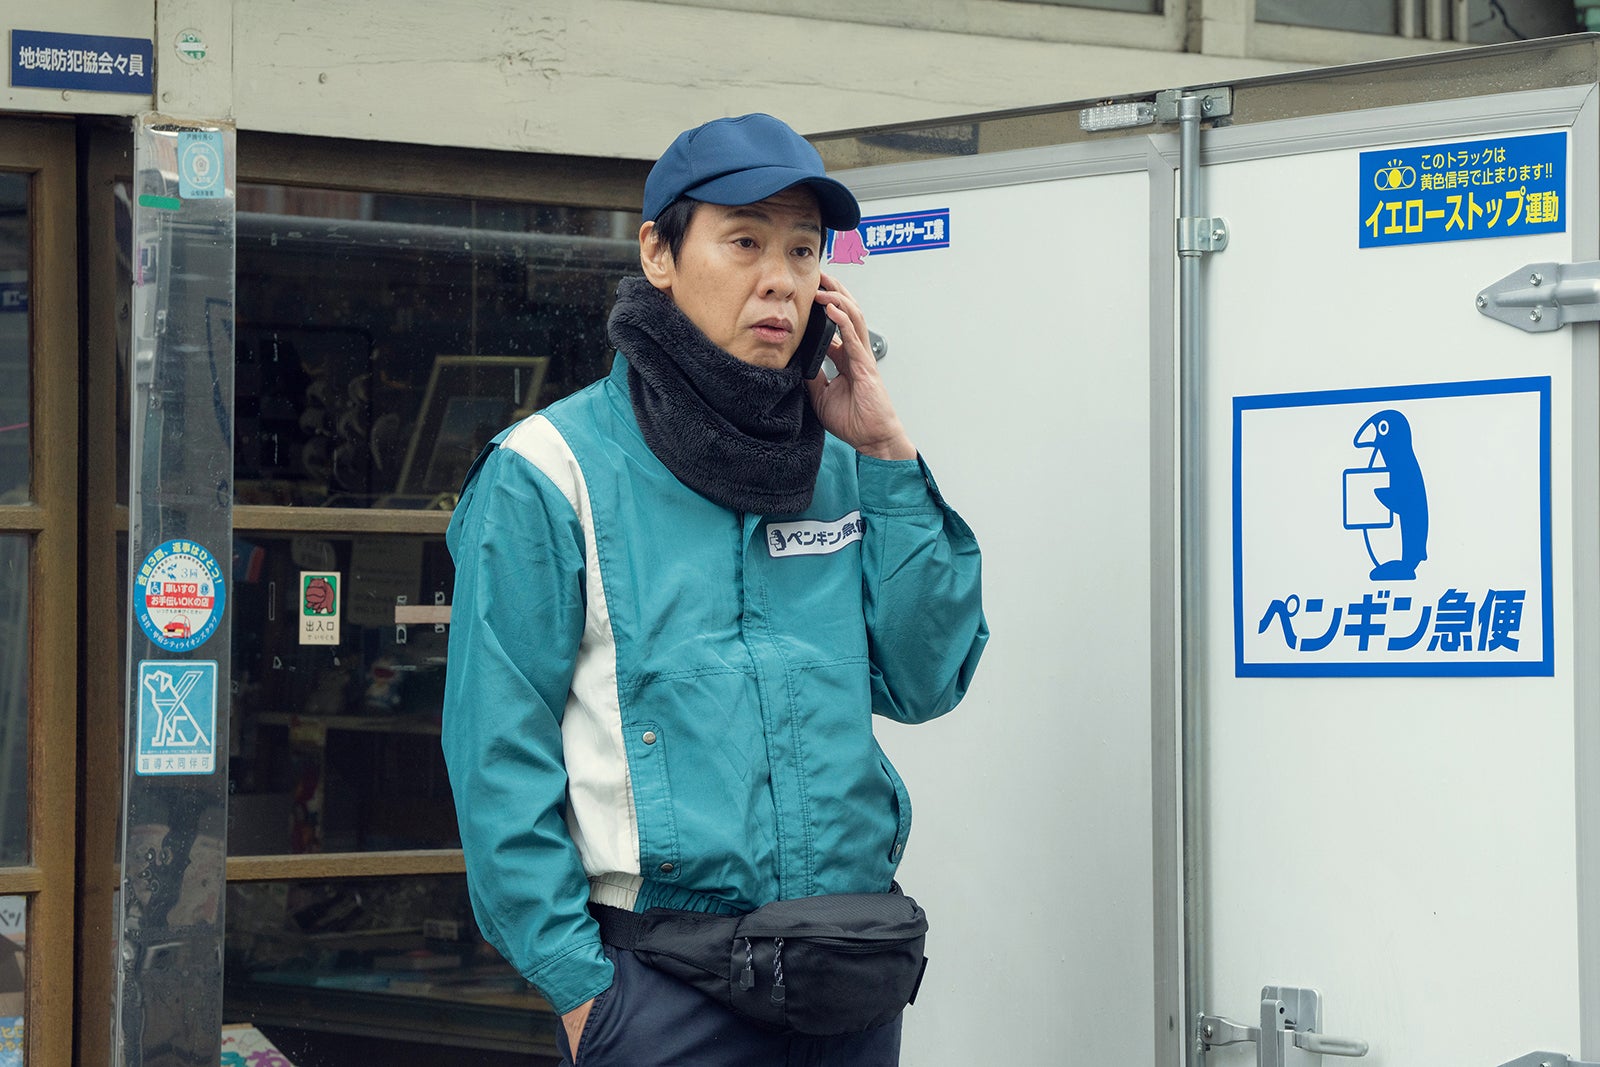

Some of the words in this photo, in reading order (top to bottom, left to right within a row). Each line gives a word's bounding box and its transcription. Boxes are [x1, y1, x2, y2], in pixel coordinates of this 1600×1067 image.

[19, 46, 144, 77] 地域防犯協会々員
[1421, 147, 1506, 170] このトラックは
[1365, 186, 1559, 238] イエローストップ運動
[165, 584, 196, 593] 車いすの
[151, 597, 209, 607] お手伝いOKの店
[306, 620, 335, 632] 出入口
[1258, 588, 1526, 652] ペンギン急便
[142, 757, 209, 770] 盲導犬同伴可
